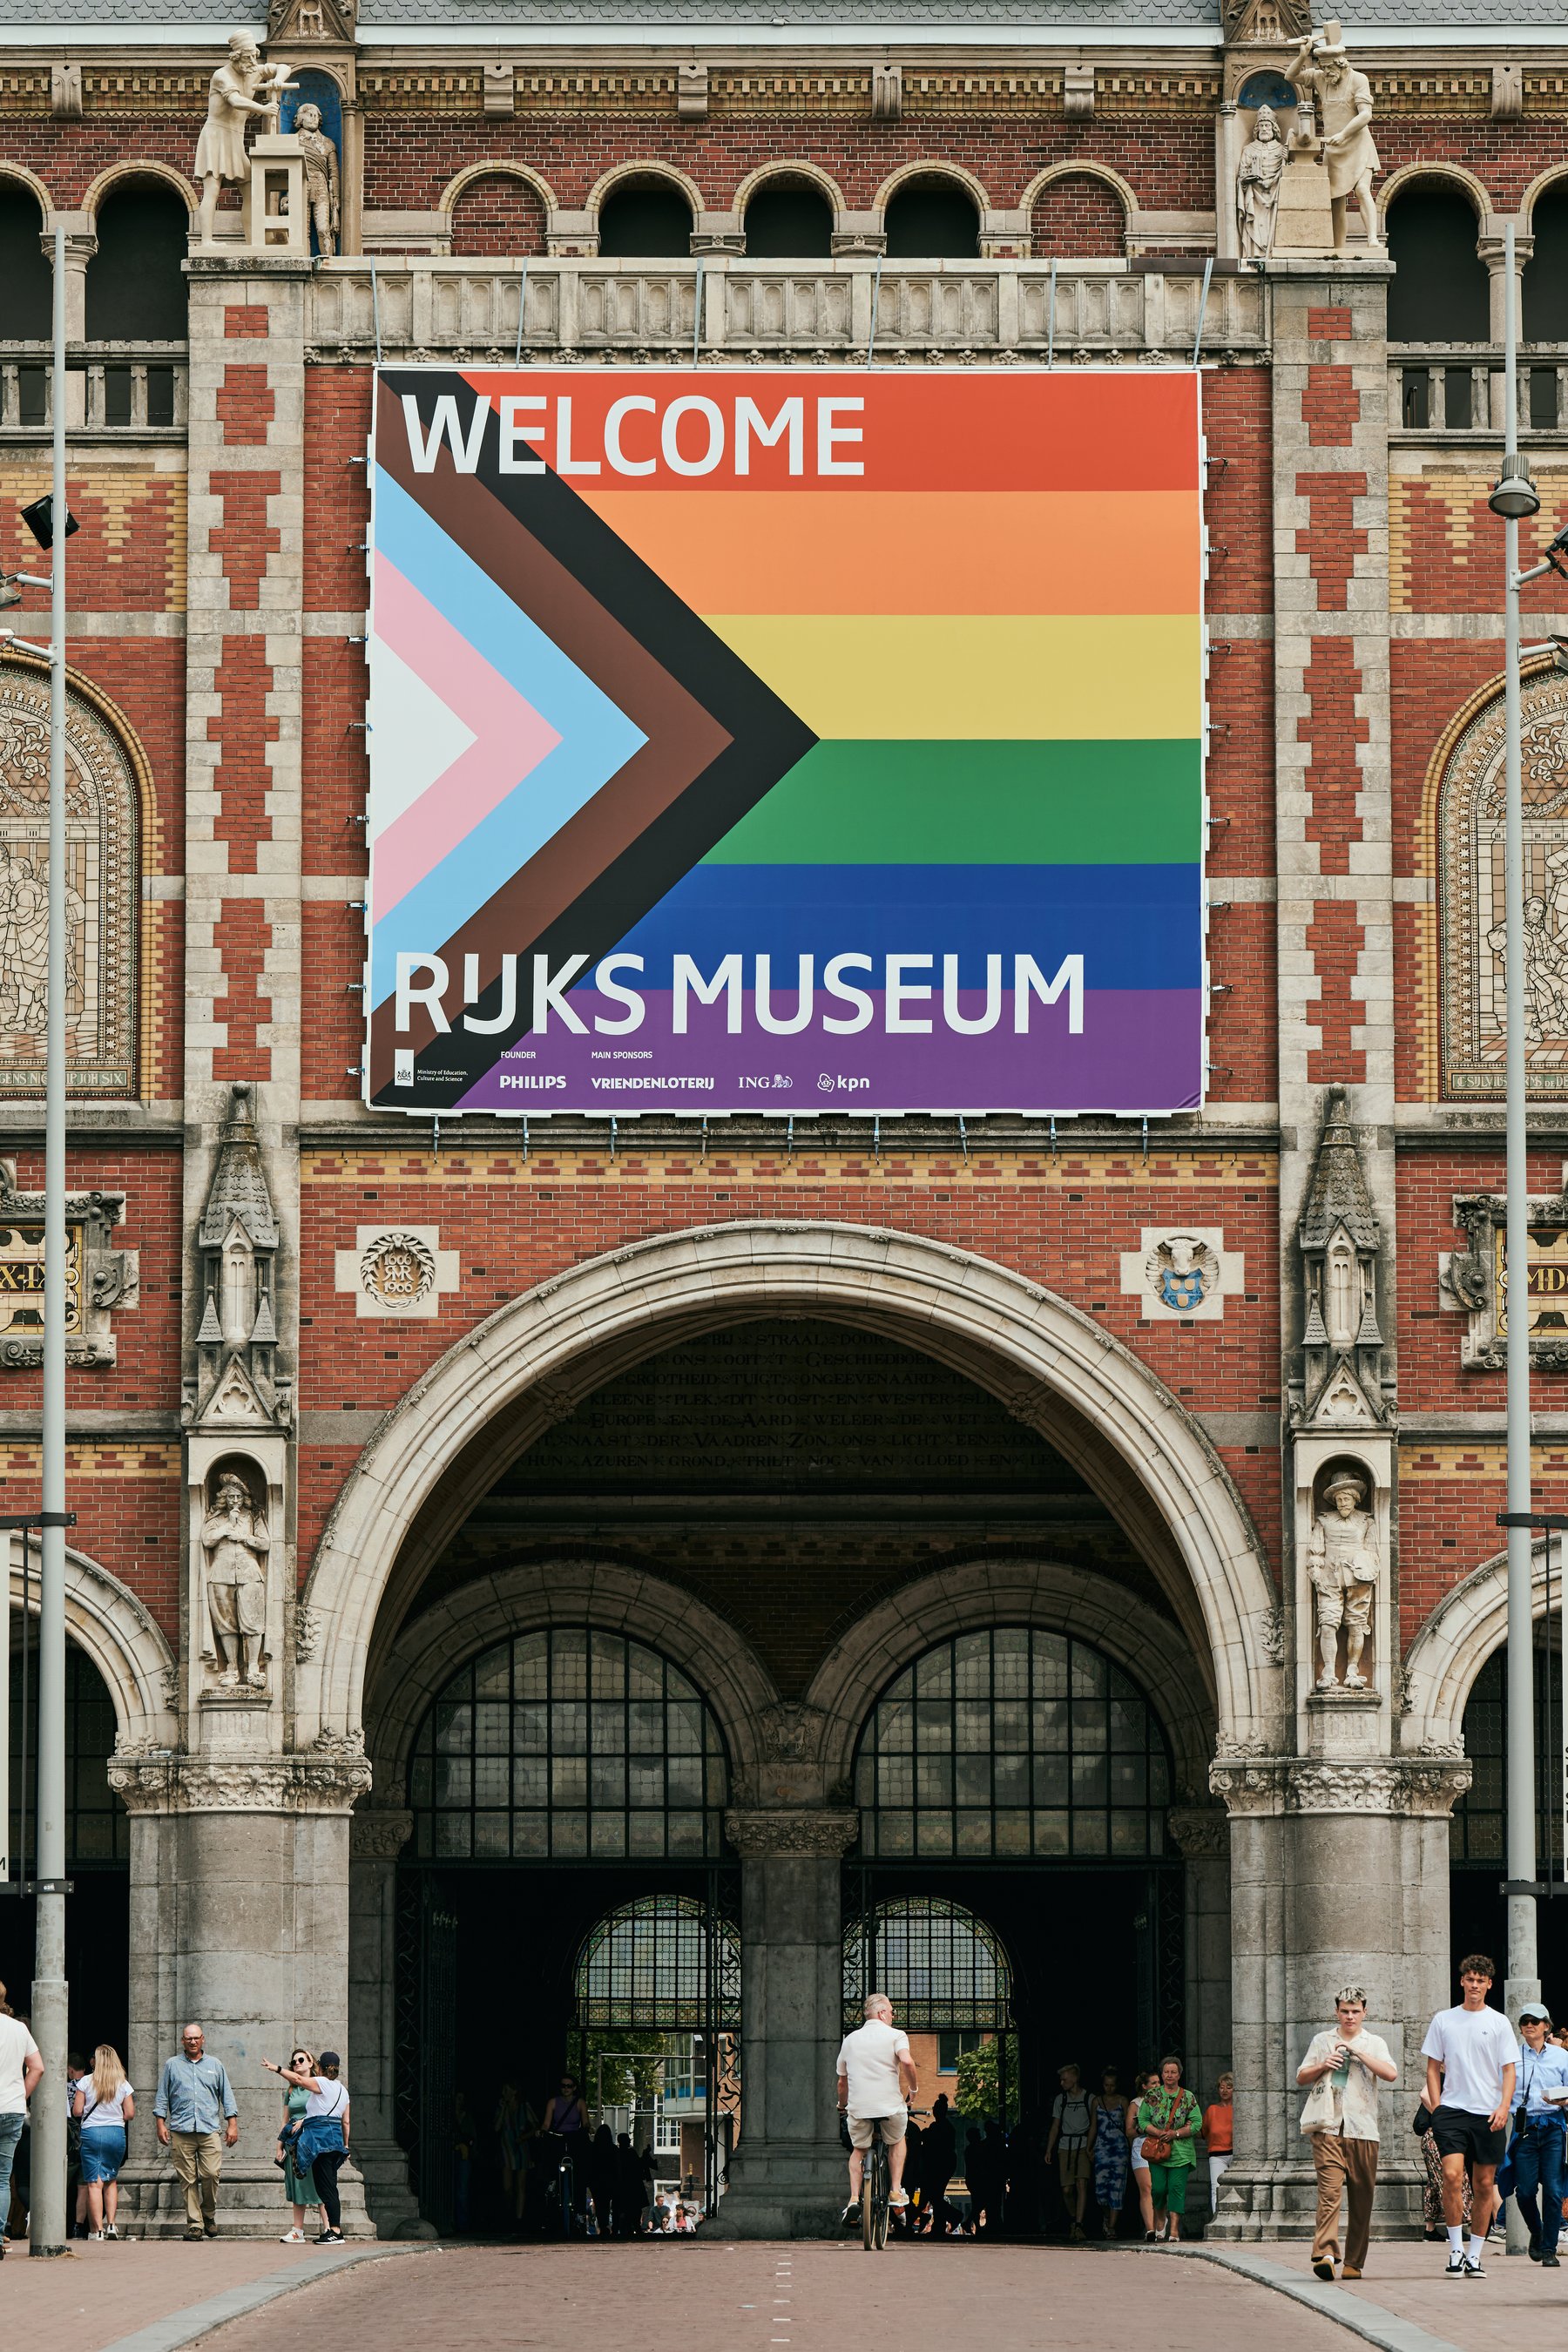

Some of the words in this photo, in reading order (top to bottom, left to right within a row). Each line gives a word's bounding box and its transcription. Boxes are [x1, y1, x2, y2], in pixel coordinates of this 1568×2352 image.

[401, 395, 865, 476] WELCOME
[672, 952, 1085, 1036] MUSEUM
[500, 1051, 537, 1059] FOUNDER
[591, 1051, 612, 1059] MAIN
[612, 1051, 653, 1059] SPONSORS
[499, 1075, 567, 1089] PHILIPS
[591, 1077, 714, 1091] VRIENDENLOTERIJ
[738, 1076, 771, 1089] ING
[837, 1074, 870, 1092] kpn
[384, 1254, 412, 1266] 1606
[384, 1281, 413, 1294] 1906
[756, 1335, 826, 1346] STRAAL
[840, 1335, 885, 1346] DOOR
[672, 1355, 706, 1366] ONS
[625, 1373, 718, 1385] GROOTHEID
[591, 1394, 654, 1405] KLEENE
[730, 1394, 756, 1405] DIT
[776, 1394, 821, 1405] OOST
[835, 1394, 858, 1405] EN
[877, 1394, 947, 1405] WESTER
[669, 1414, 693, 1426] EN
[710, 1414, 733, 1426] DE
[813, 1414, 883, 1426] WELEER
[900, 1414, 923, 1425] DE
[943, 1413, 981, 1425] WET
[570, 1435, 633, 1447] NAAST
[646, 1435, 681, 1447] DER
[841, 1435, 876, 1447] ONS
[891, 1434, 941, 1446] LICHT
[956, 1434, 990, 1446] EEN
[527, 1455, 563, 1467] HUN
[581, 1455, 648, 1467] AZUREN
[808, 1455, 841, 1467] NOG
[859, 1455, 895, 1467] VAN
[914, 1454, 970, 1466] GLOED
[988, 1454, 1011, 1466] EN
